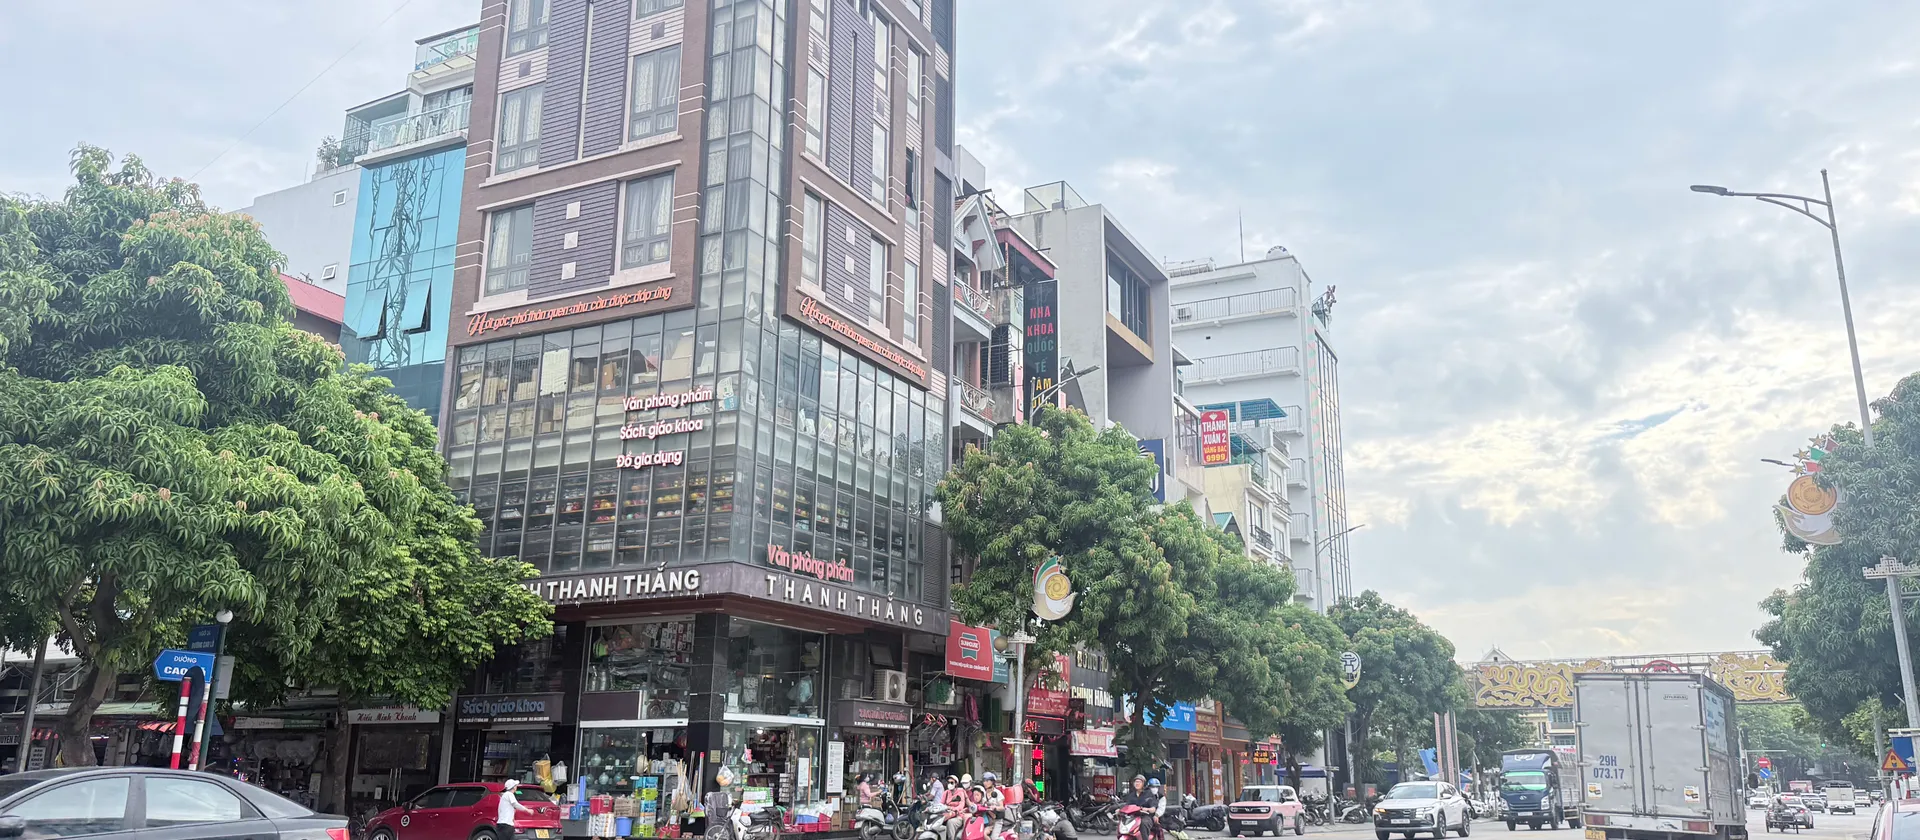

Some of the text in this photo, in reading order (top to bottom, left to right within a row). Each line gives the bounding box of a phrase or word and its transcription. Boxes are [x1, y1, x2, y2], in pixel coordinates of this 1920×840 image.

[546, 305, 568, 321] quen
[572, 301, 588, 313] nhu
[609, 293, 632, 307] được
[634, 288, 652, 304] đáp
[1030, 306, 1051, 319] NHA
[1027, 323, 1054, 337] KHOA
[1027, 337, 1055, 354] QUỐC
[1035, 357, 1048, 374] TẾ
[623, 386, 713, 411] Văn phòng phẩm
[620, 418, 703, 439] Sách giáo khoa
[1203, 432, 1227, 444] XUÂN 2
[616, 450, 683, 469] Đồ gia dụng
[1206, 453, 1226, 462] 9999
[767, 543, 854, 582] Văn phòng phẩm
[547, 575, 618, 600] THANH
[623, 561, 700, 595] THẮNG
[766, 575, 923, 626] THANH THẮNG
[174, 655, 197, 664] ĐƯỜNG
[164, 666, 188, 676] CAO
[1071, 683, 1094, 706] CHÍNH
[462, 696, 545, 717] Sách giáo khoa
[1599, 755, 1617, 767] 29H
[1593, 767, 1624, 780] 073.17
